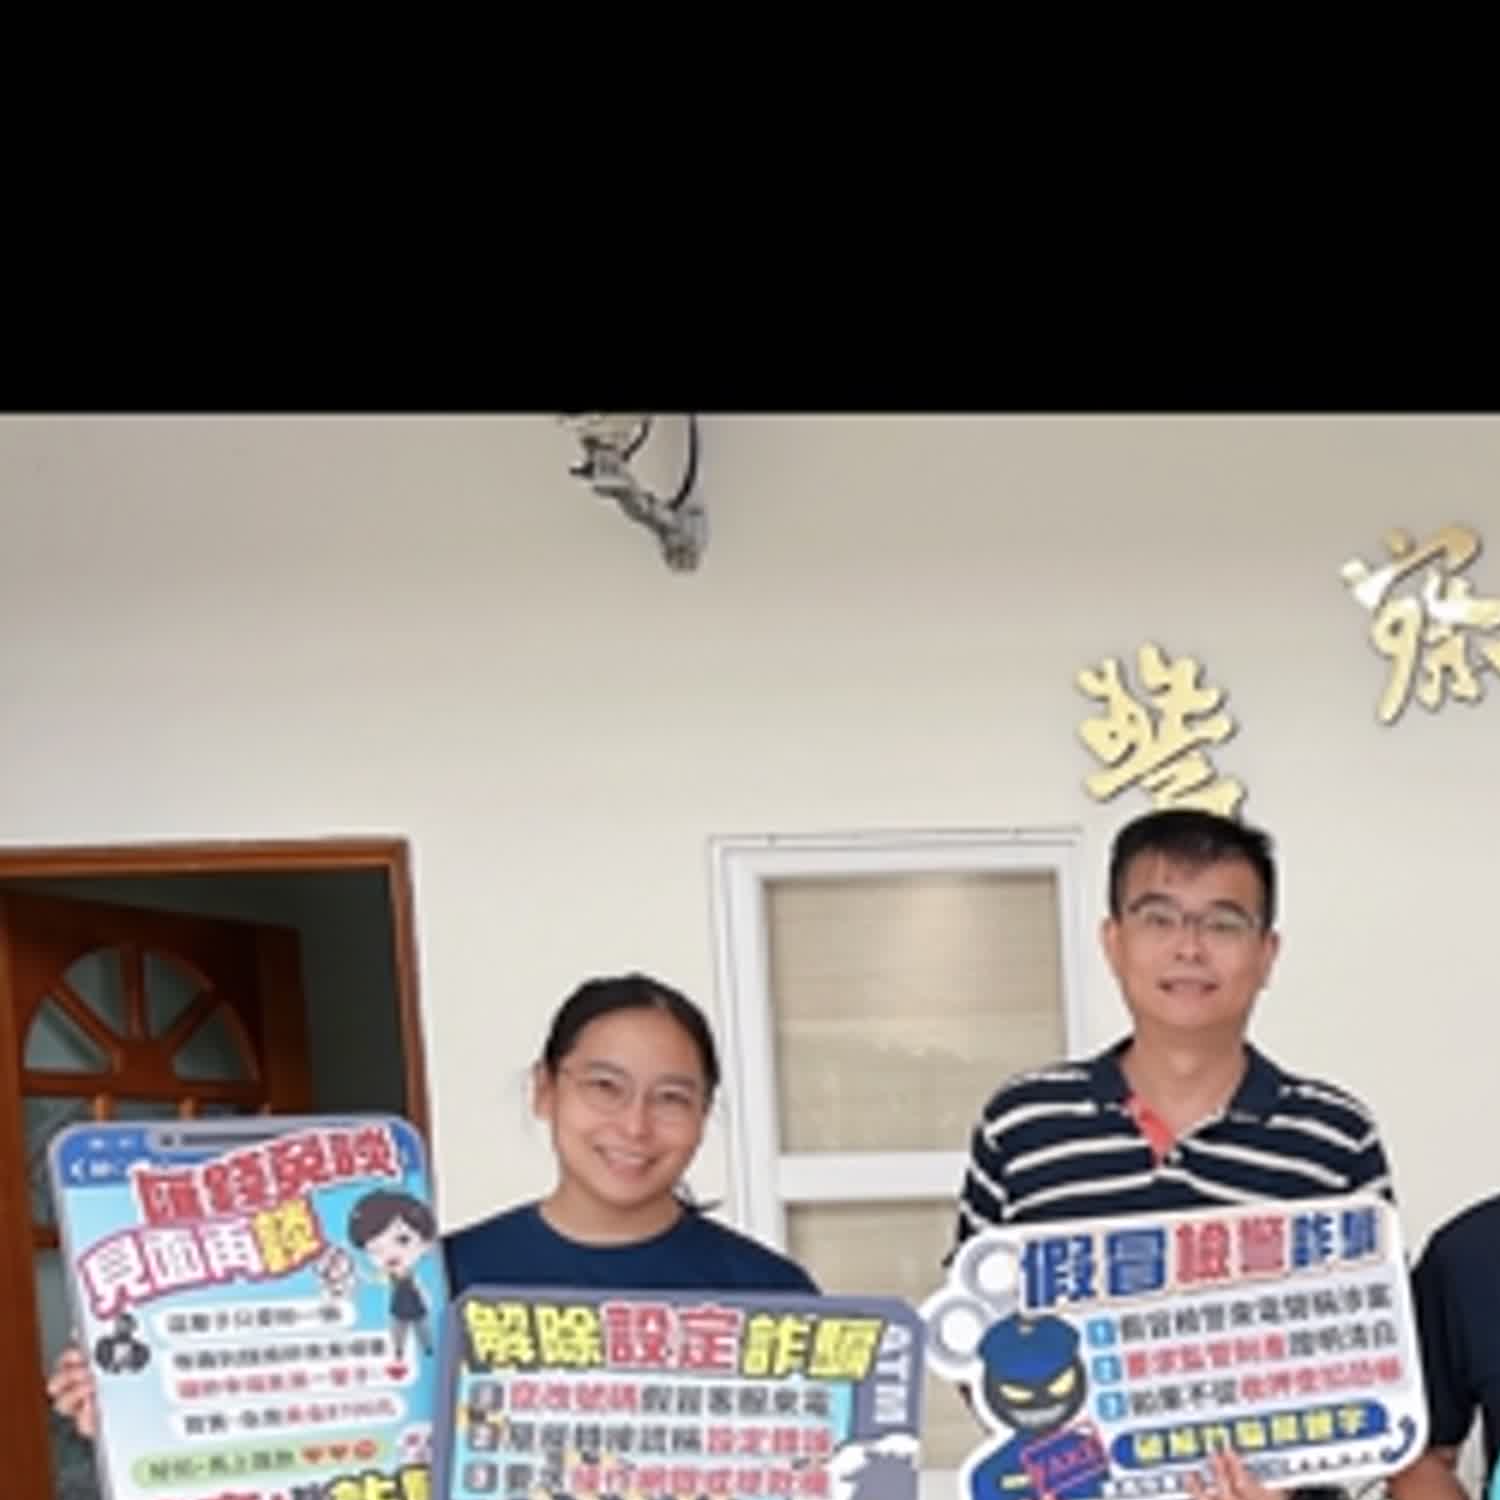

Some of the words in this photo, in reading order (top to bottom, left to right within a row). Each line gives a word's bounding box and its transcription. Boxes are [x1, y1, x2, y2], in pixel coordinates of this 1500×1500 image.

[1021, 1207, 1376, 1308] 假冒檢警詐騙
[464, 1302, 883, 1378] 解除設定詐騙
